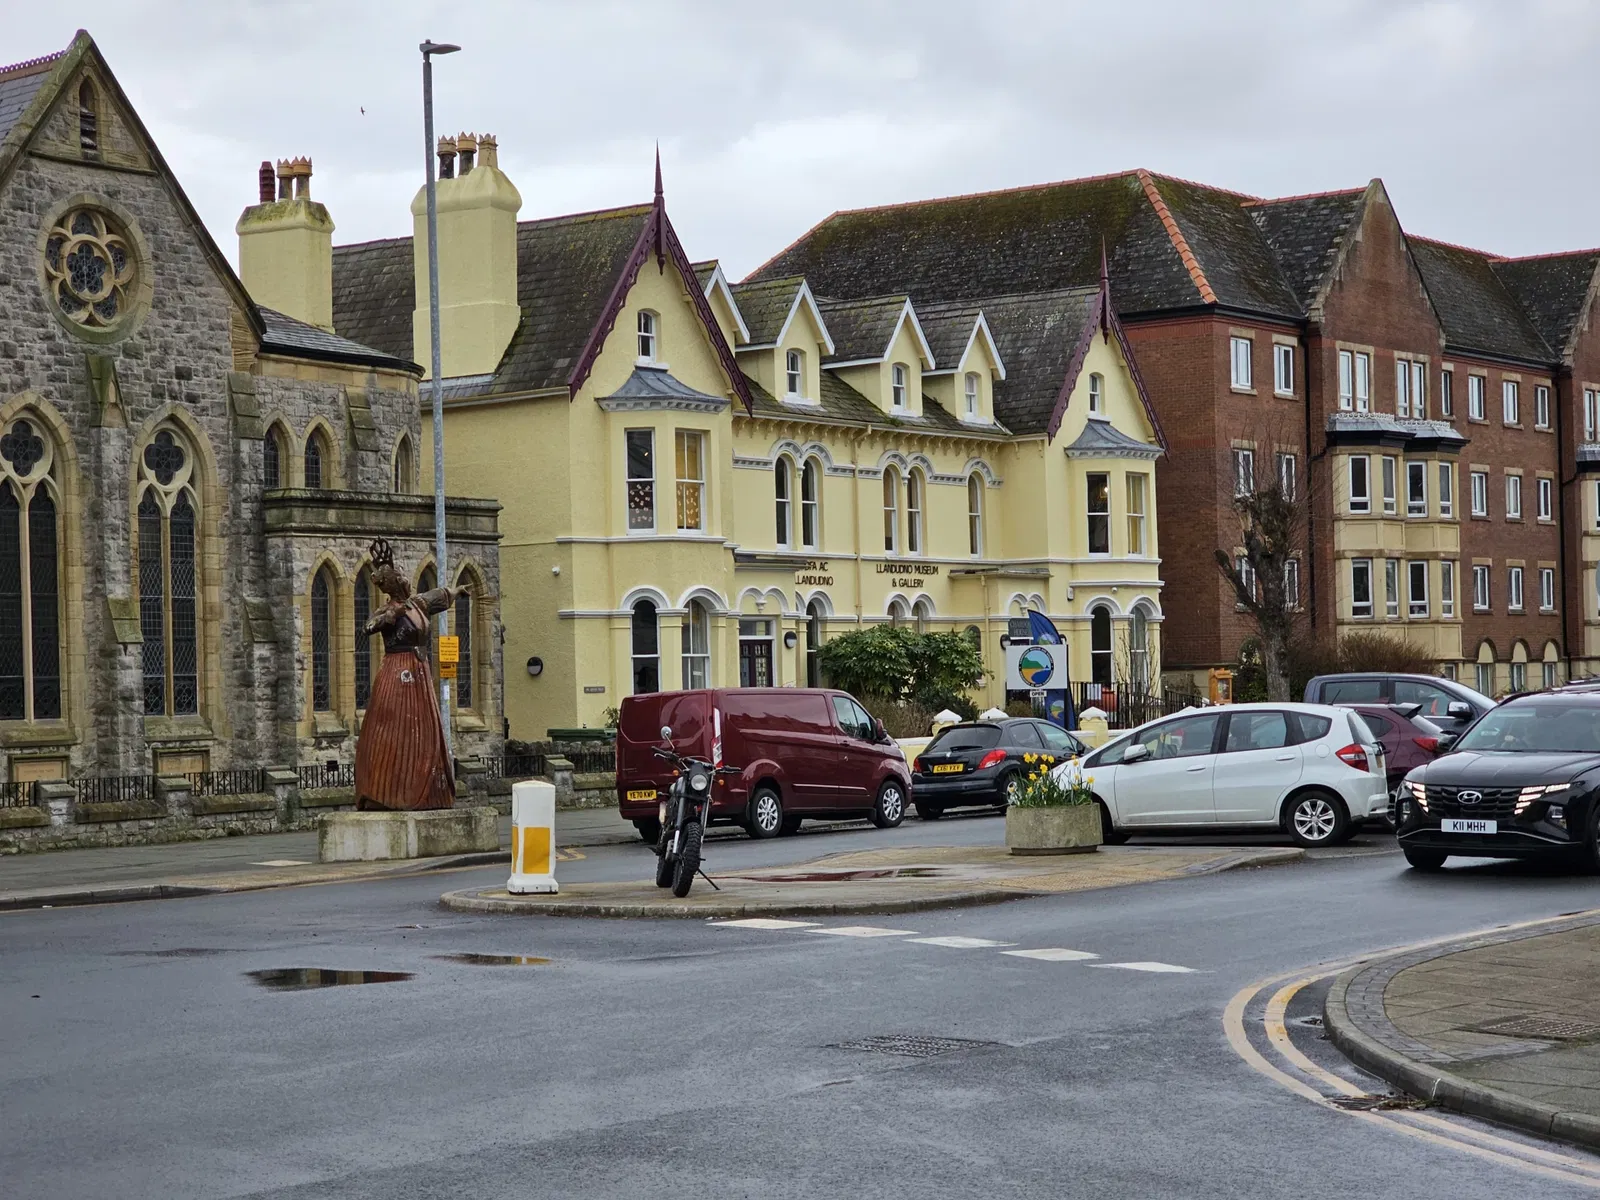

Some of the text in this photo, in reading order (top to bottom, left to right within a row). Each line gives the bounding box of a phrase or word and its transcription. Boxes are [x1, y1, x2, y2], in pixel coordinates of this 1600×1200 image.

[819, 561, 829, 571] AC
[876, 563, 939, 575] LLANDUDNO MUSEUM
[892, 577, 924, 588] & GALLERY
[1466, 821, 1486, 832] MHH
